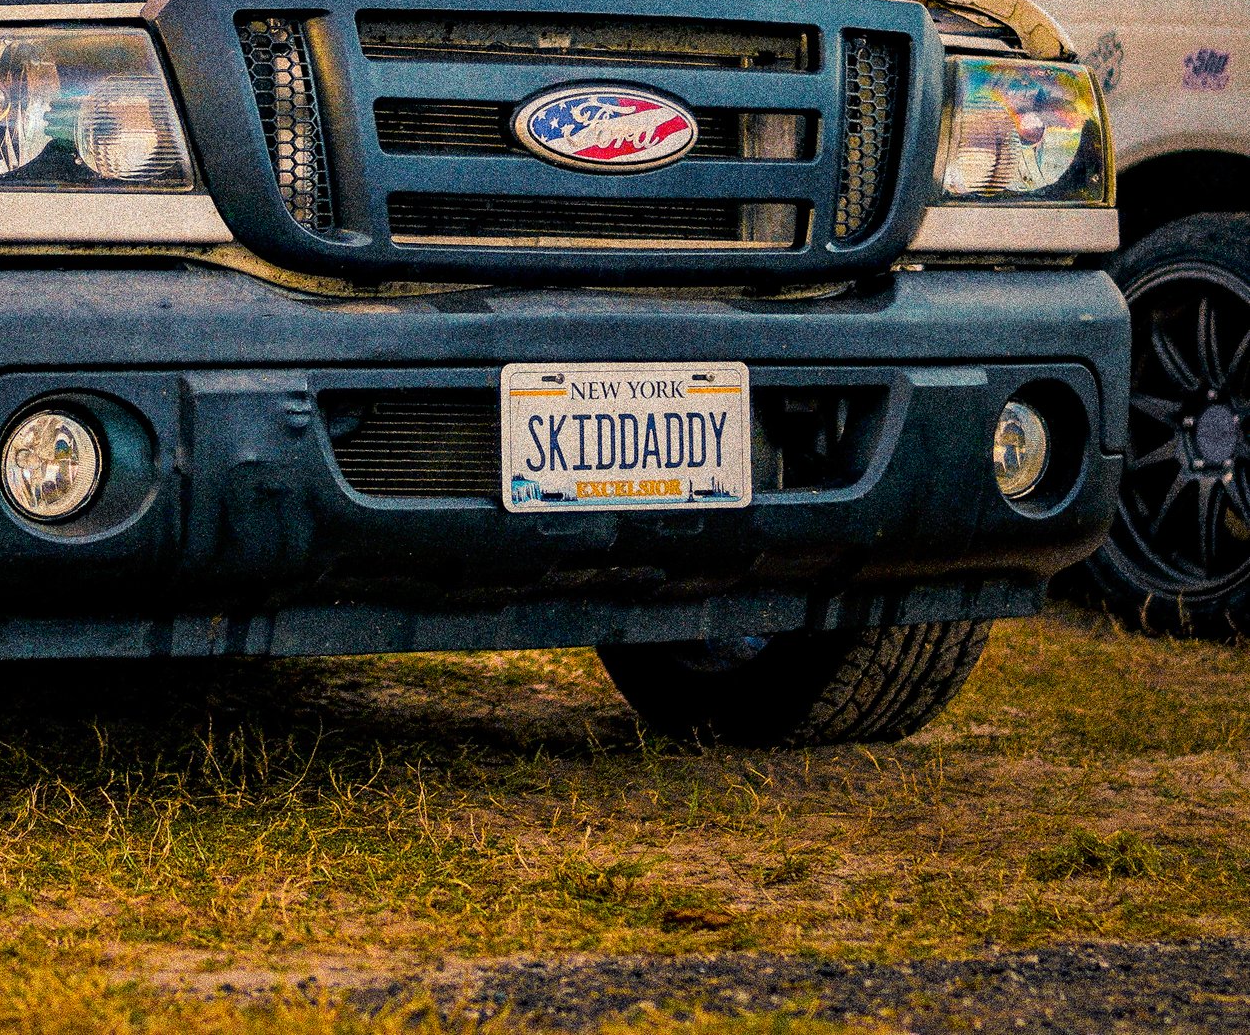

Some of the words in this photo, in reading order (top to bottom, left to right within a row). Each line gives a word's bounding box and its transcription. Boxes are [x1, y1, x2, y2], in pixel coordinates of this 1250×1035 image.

[561, 96, 661, 149] Ford
[570, 381, 621, 400] NEW
[626, 380, 686, 399] YORK
[526, 411, 727, 473] SKIDDADDY
[575, 478, 683, 500] EXCELSIOR
